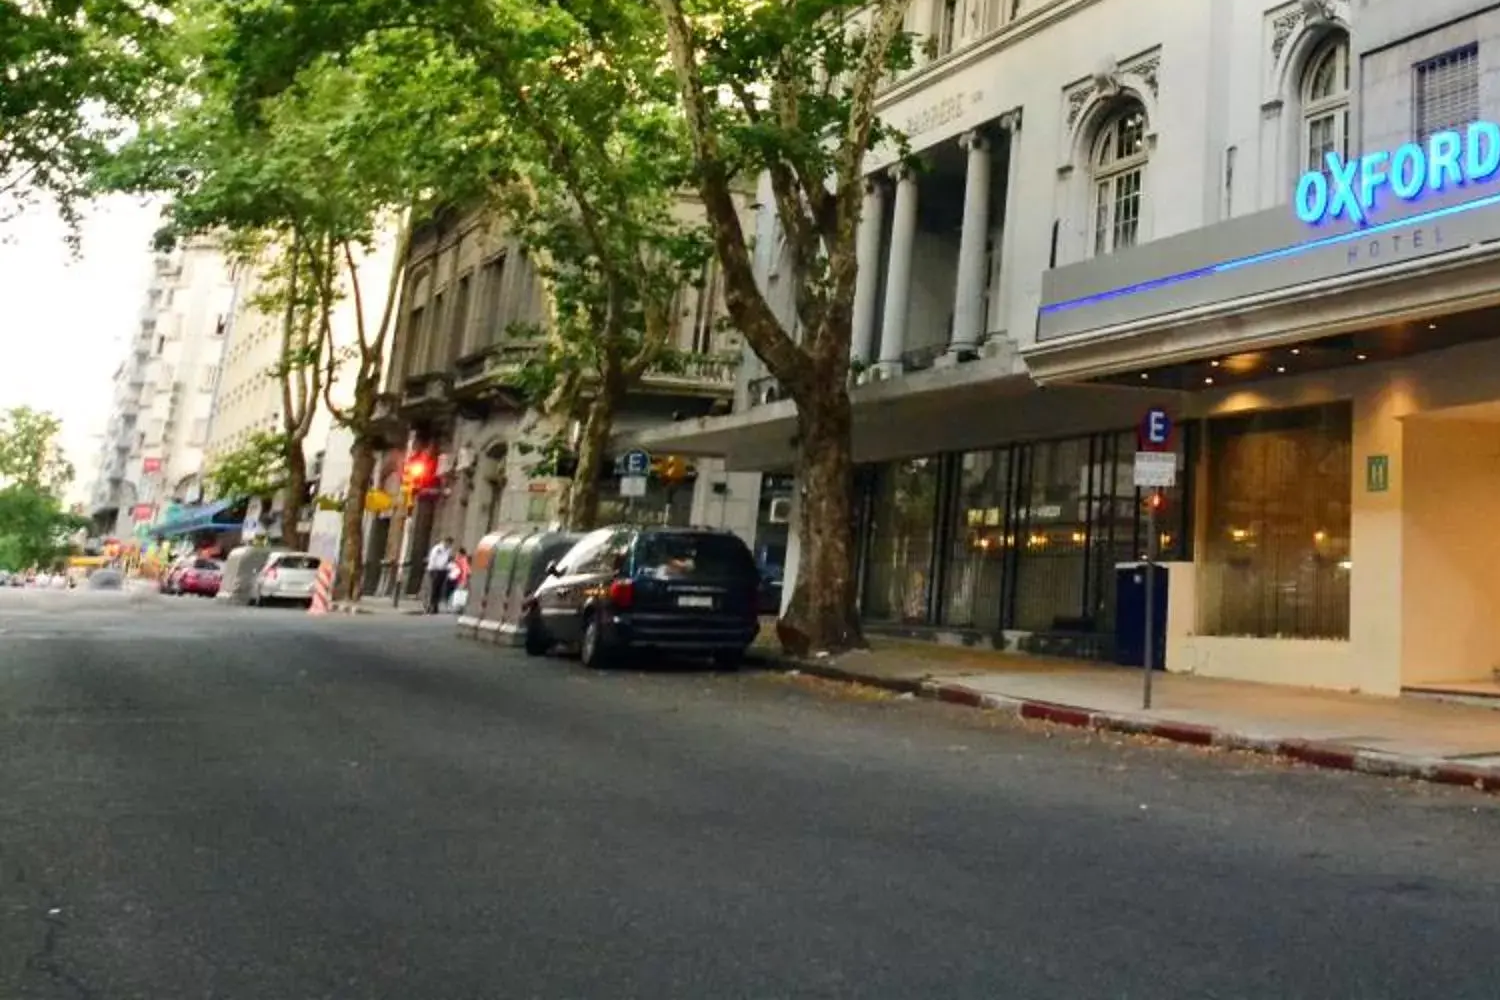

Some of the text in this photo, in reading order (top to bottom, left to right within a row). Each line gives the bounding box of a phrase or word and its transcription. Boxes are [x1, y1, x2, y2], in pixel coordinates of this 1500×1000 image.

[1347, 226, 1443, 264] HOTEL
[1149, 411, 1165, 442] E
[629, 453, 642, 471] E
